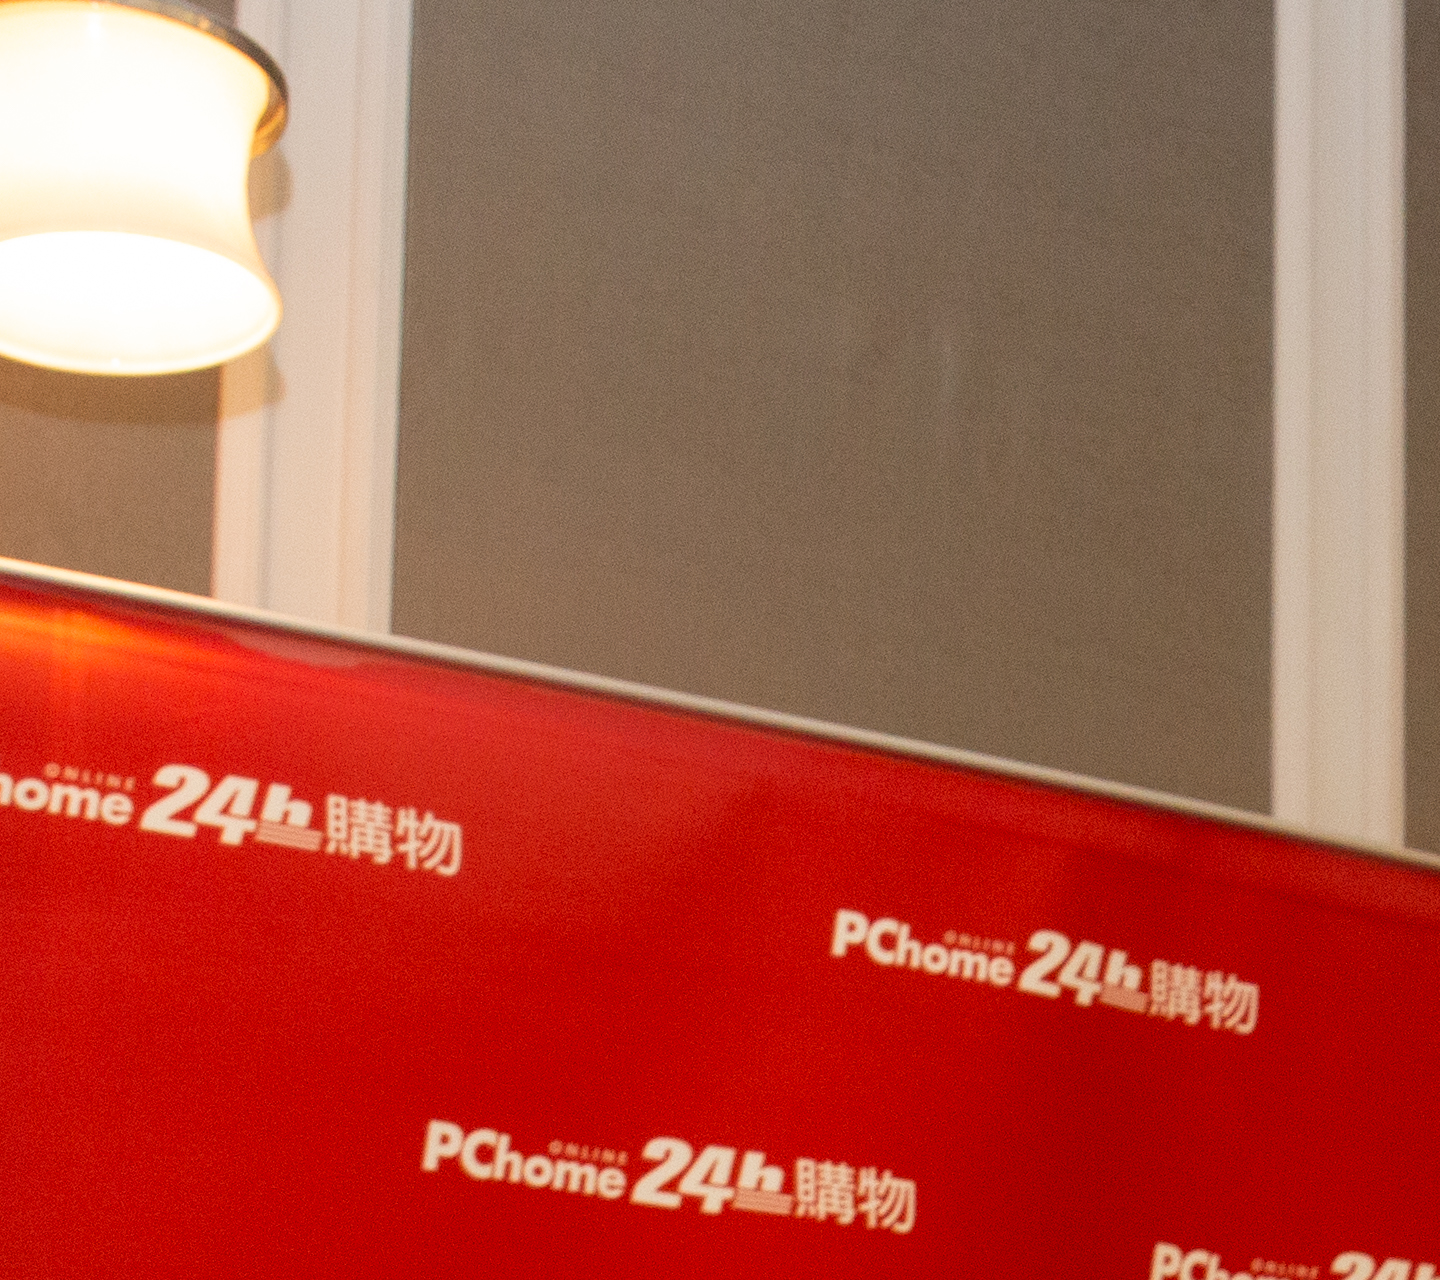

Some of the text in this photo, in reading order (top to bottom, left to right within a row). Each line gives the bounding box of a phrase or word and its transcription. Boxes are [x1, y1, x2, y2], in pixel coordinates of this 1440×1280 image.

[43, 761, 136, 792] ONLINE
[831, 908, 1015, 987] PChome
[422, 1119, 627, 1199] PChome
